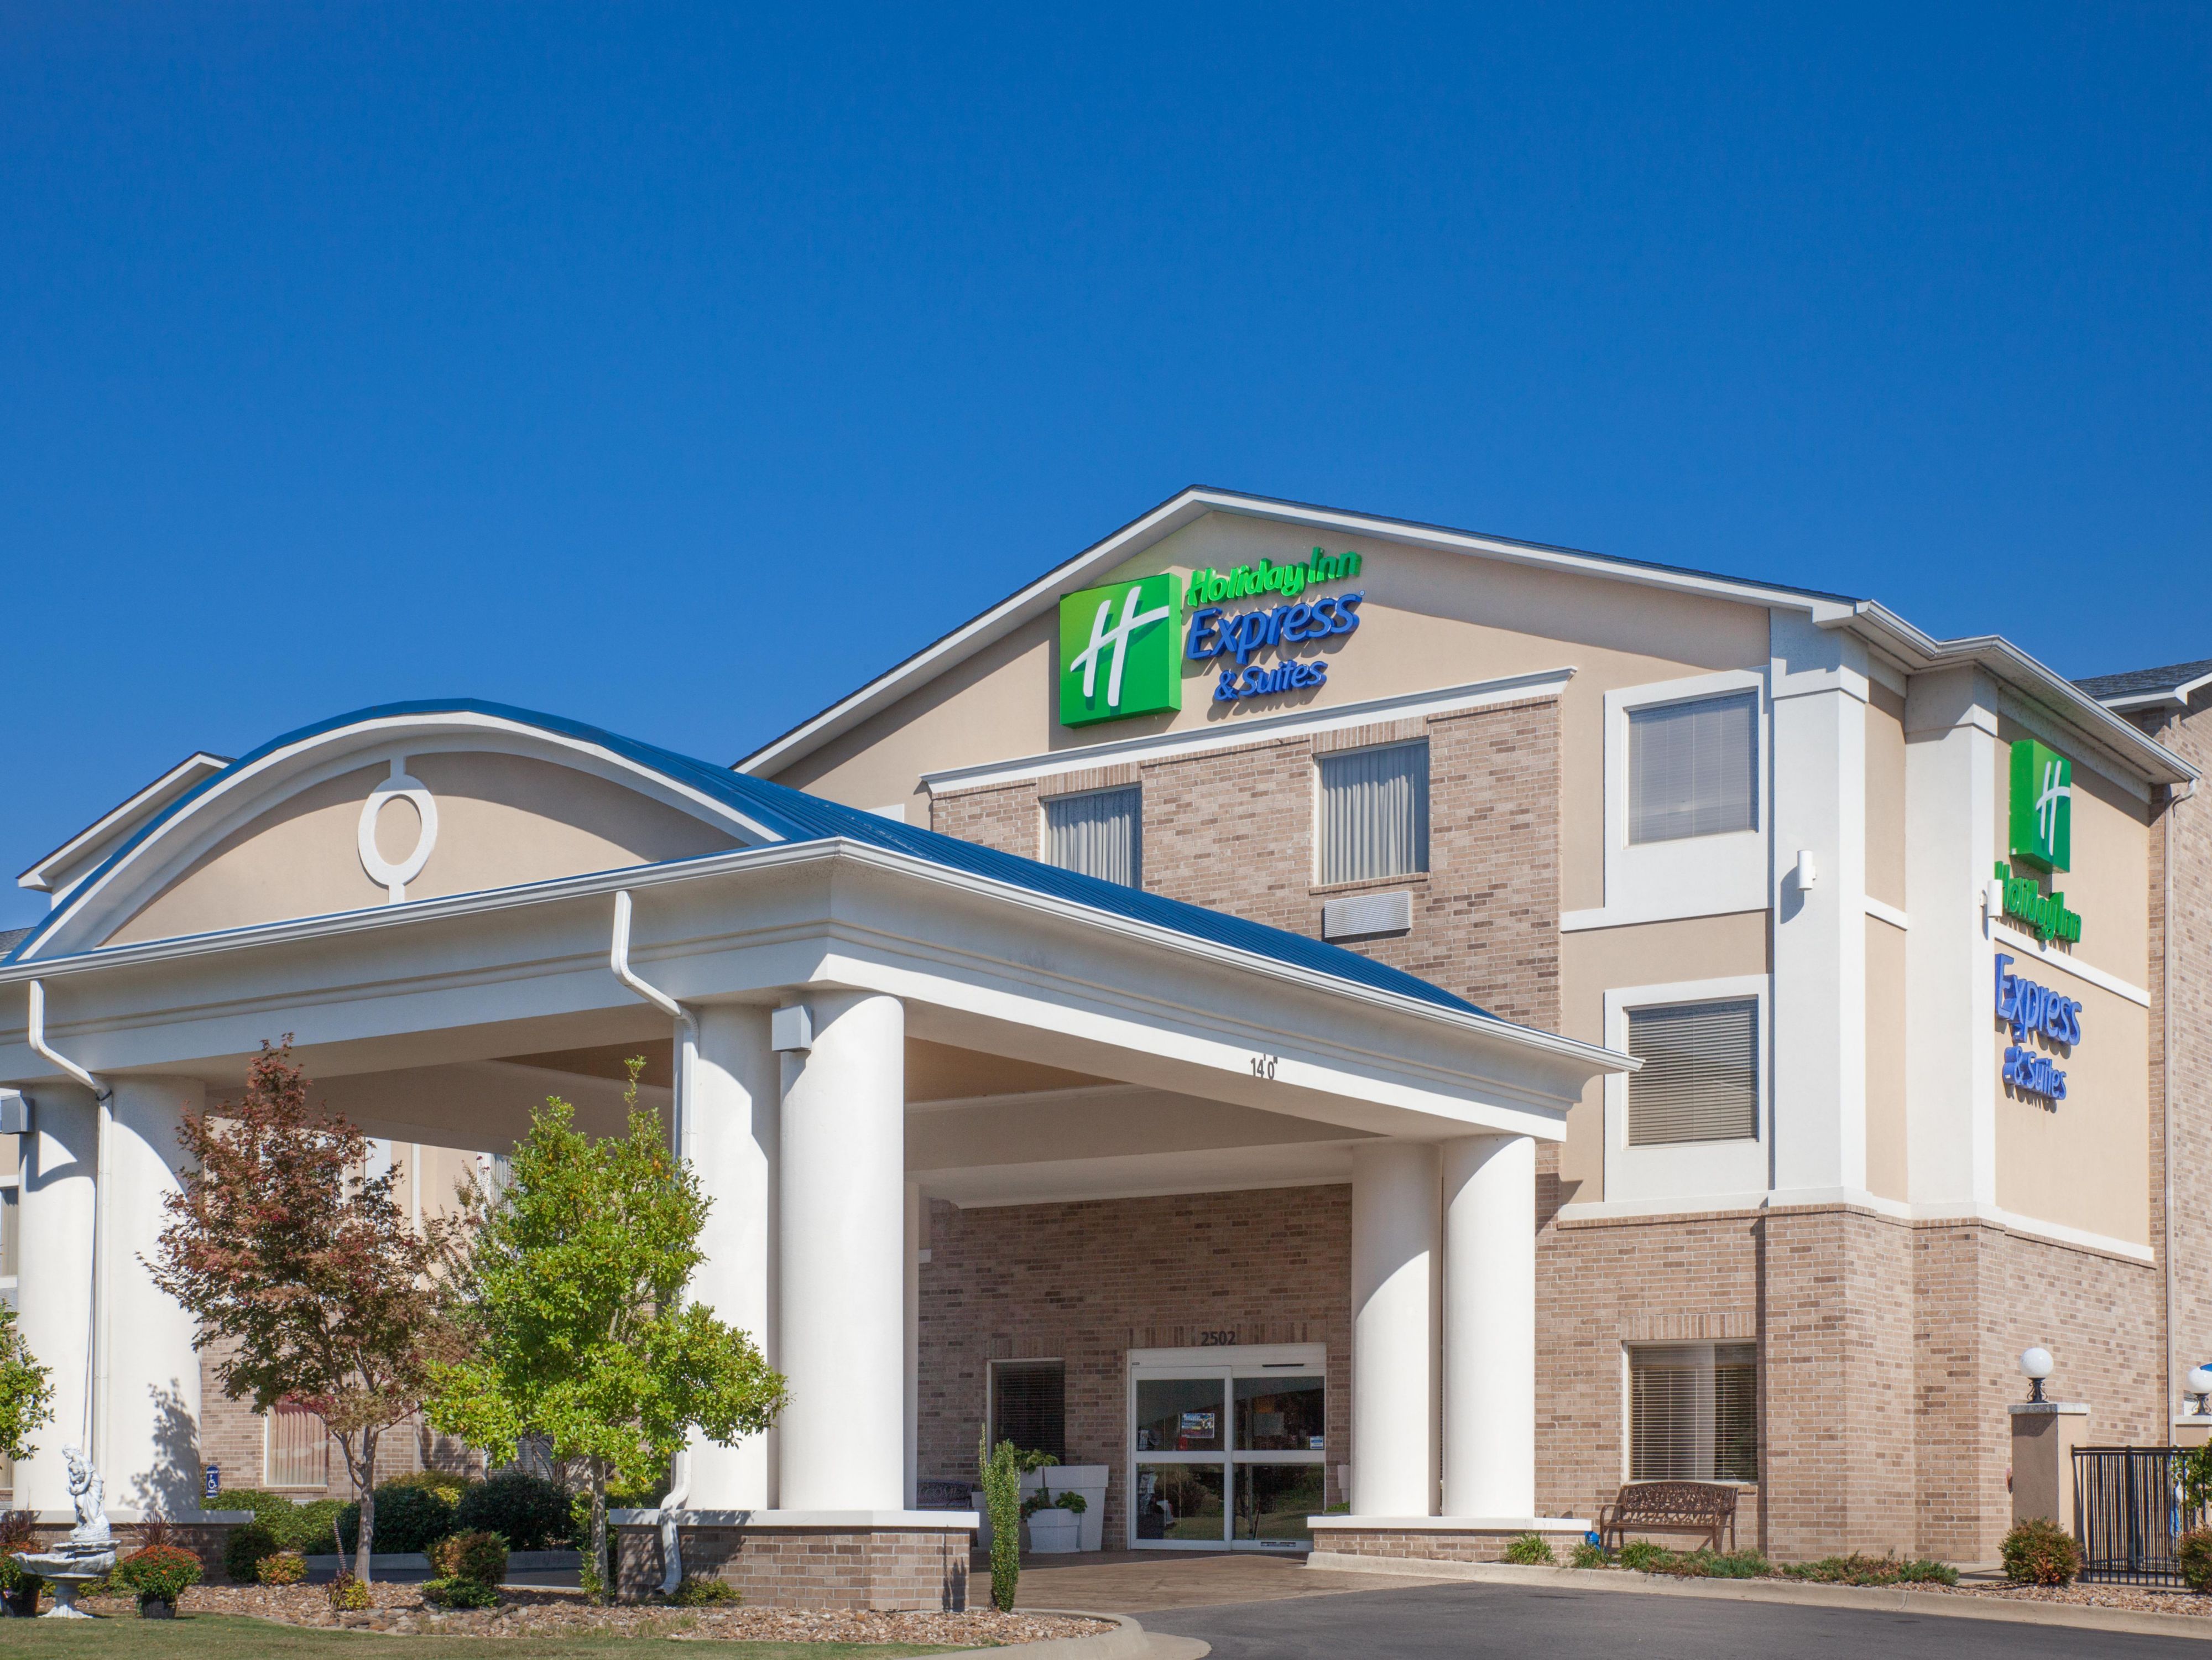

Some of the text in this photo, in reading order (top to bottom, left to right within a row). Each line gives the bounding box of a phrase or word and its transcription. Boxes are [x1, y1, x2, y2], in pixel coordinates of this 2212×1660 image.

[1186, 547, 1362, 607] Holiday Inn
[1186, 594, 1363, 665] Express
[1214, 659, 1328, 701] & Suites
[2052, 891, 2081, 943] Inn
[1995, 953, 2082, 1045] Express
[2025, 1052, 2067, 1100] Suites
[1201, 1331, 1236, 1346] 2502
